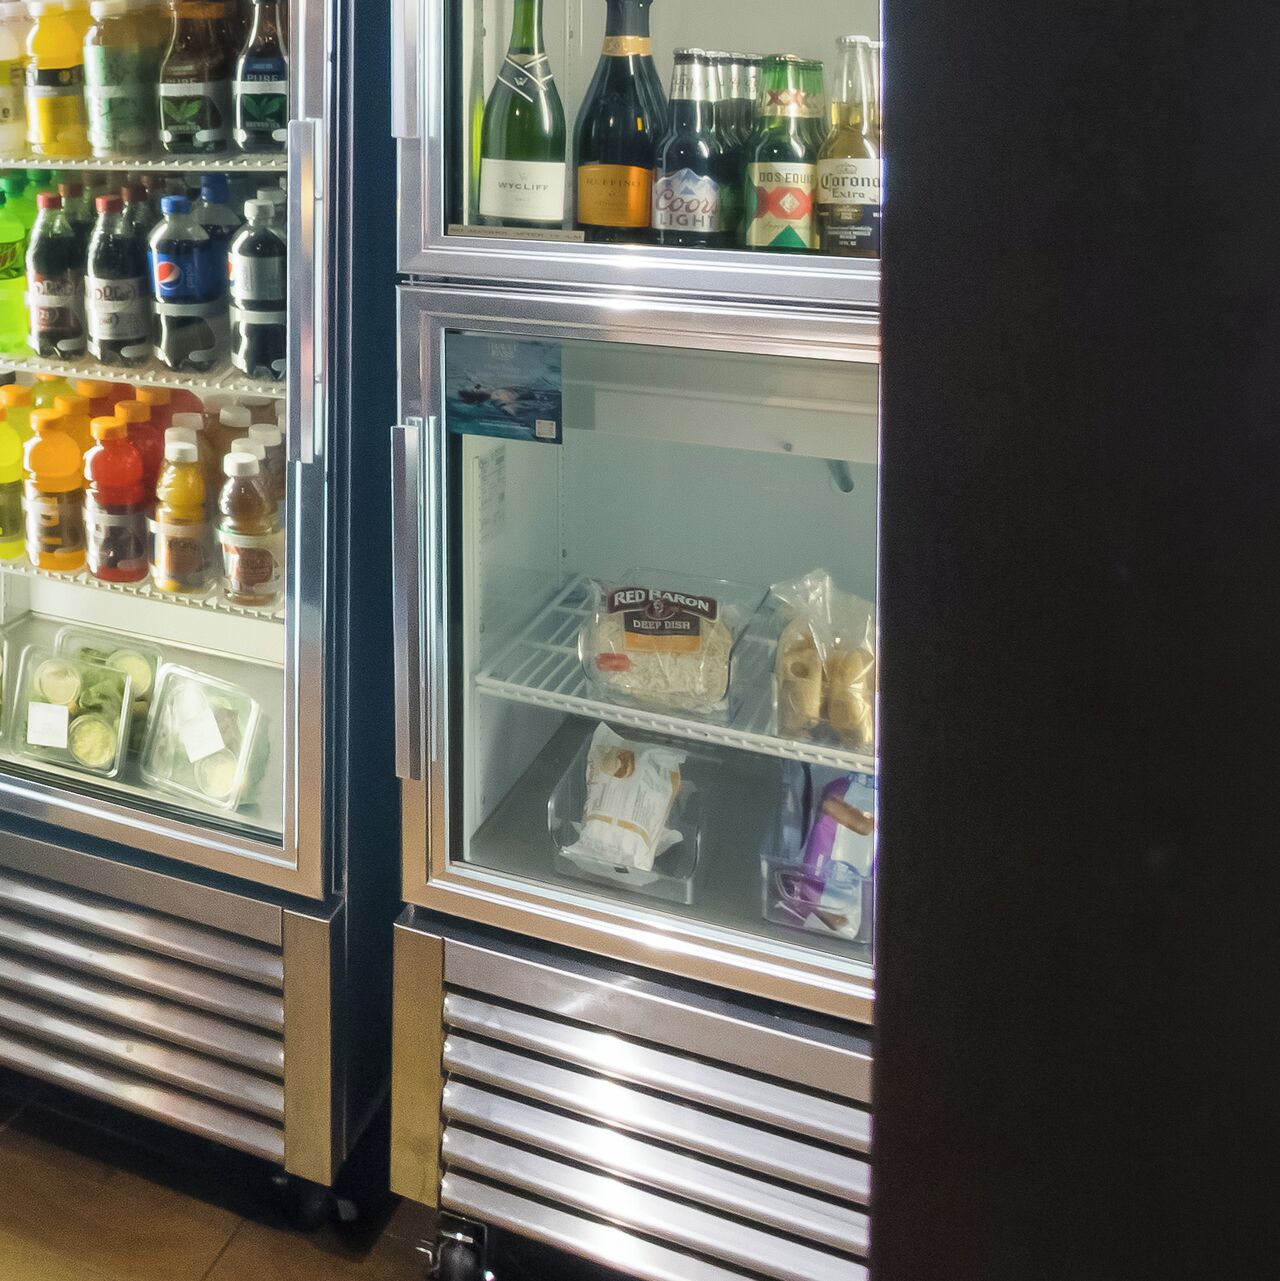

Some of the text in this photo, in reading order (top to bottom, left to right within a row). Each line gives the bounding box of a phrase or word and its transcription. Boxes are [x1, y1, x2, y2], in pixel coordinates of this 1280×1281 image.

[586, 178, 642, 187] RUFFINO
[759, 172, 781, 183] DOS
[498, 181, 550, 191] WYCLIFF
[832, 188, 865, 199] Extra
[614, 589, 710, 611] RED BARON
[633, 619, 691, 630] DEEP DISH
